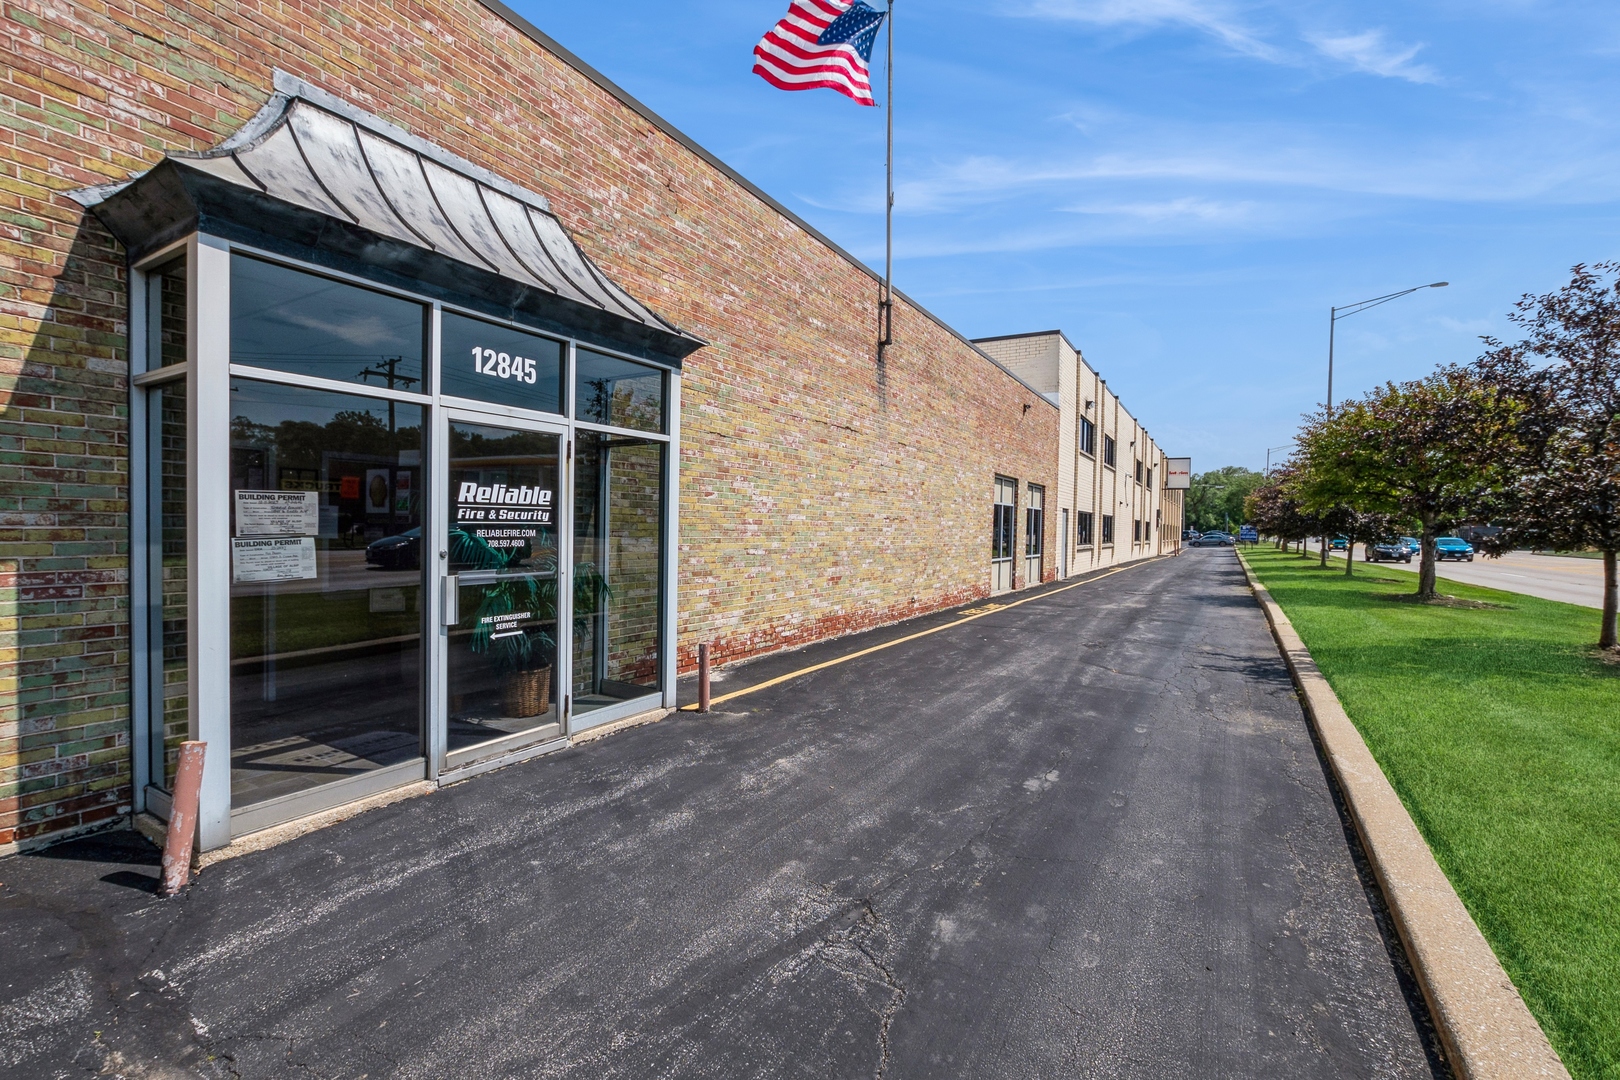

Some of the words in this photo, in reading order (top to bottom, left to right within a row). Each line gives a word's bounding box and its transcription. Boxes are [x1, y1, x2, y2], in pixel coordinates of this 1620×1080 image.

[471, 346, 537, 384] 12845
[458, 482, 552, 505] Reliable
[457, 508, 485, 519] Fire
[488, 509, 497, 520] &
[498, 509, 550, 521] Security
[476, 529, 536, 537] RELIABLEFIRE.COM
[234, 540, 272, 548] BUILDING
[487, 540, 525, 548] 708.597.4600
[481, 616, 493, 624] FIRE
[494, 612, 531, 623] EXTINGUISHER
[495, 621, 518, 630] SERVICE
